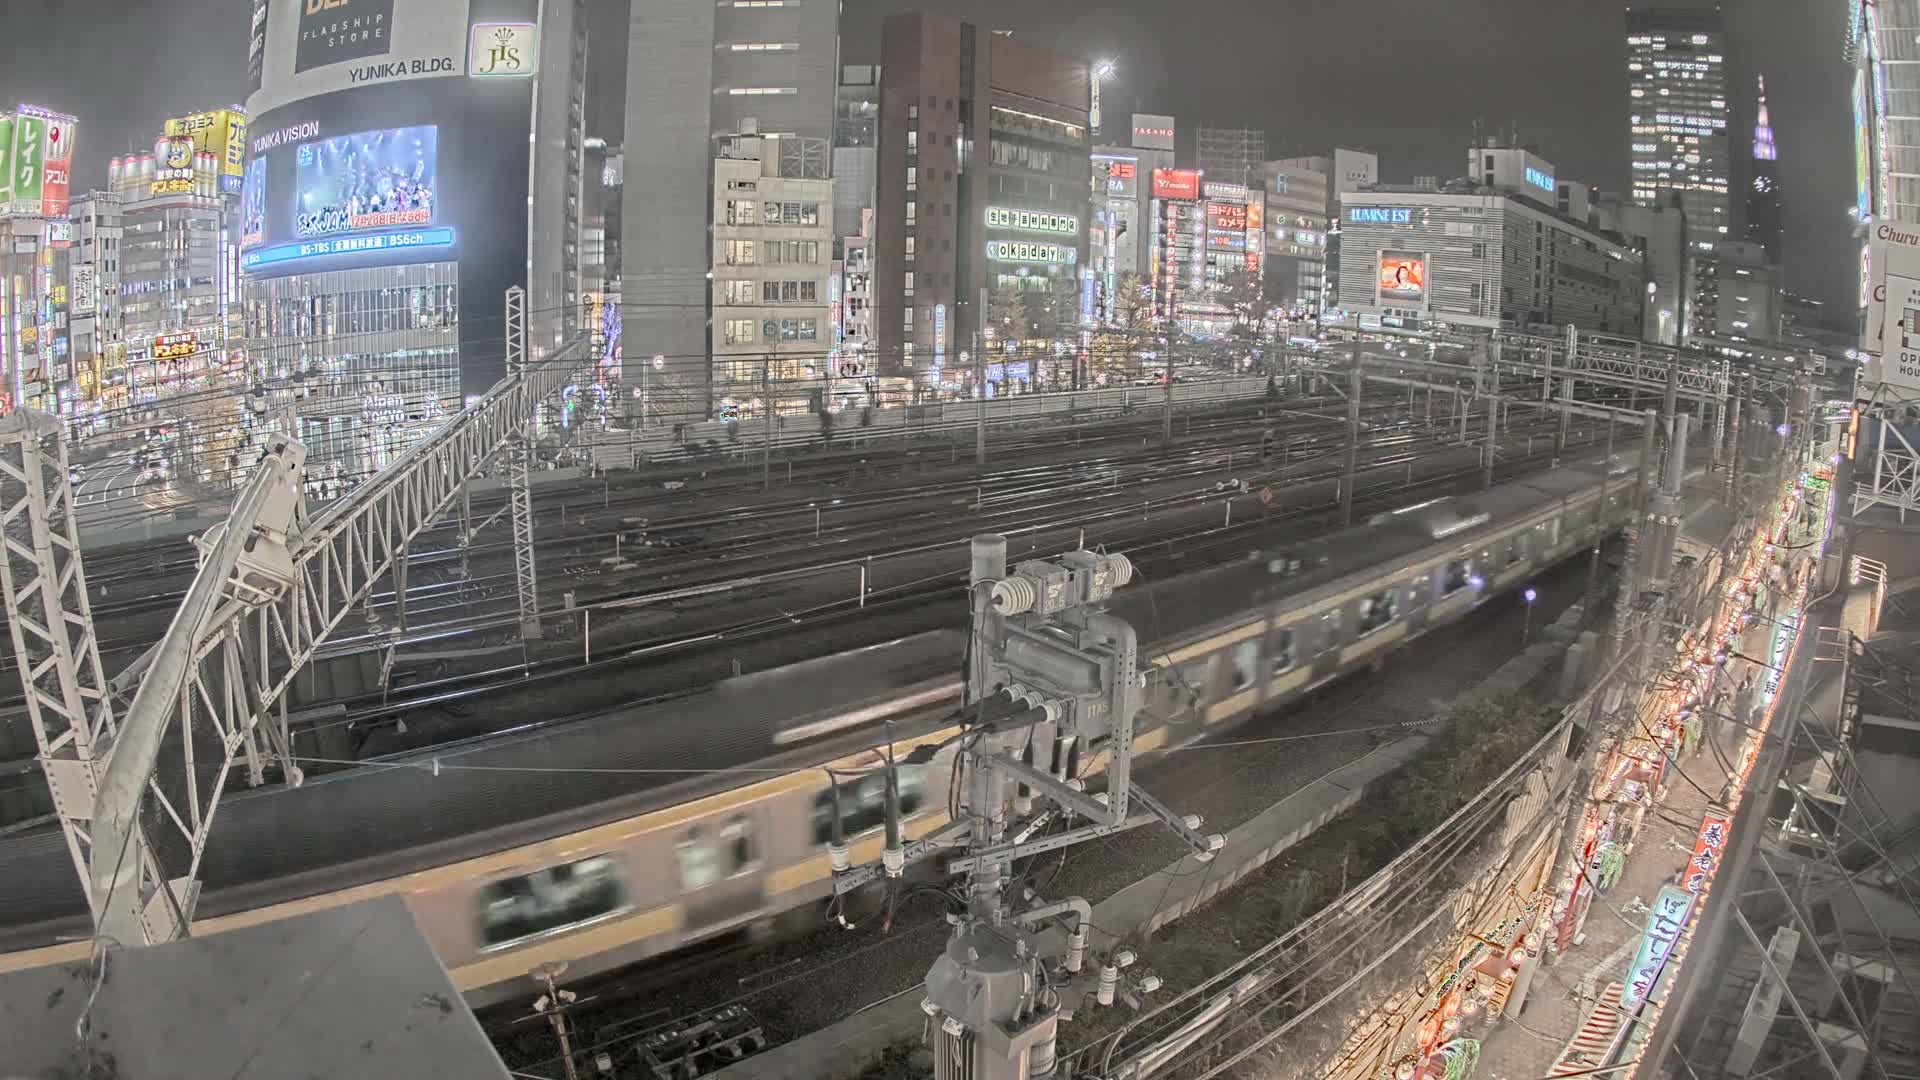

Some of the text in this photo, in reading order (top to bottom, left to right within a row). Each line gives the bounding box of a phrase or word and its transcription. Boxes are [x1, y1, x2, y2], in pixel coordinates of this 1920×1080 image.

[303, 14, 383, 40] FLAGSHIP
[329, 29, 382, 47] STORE
[350, 58, 456, 82] YUNIKA BLDG.
[254, 121, 320, 152] YUNIKA VISION
[1134, 128, 1173, 136] TAKANO
[21, 121, 37, 187] レイク
[45, 169, 68, 185] アコム
[1208, 205, 1246, 217] ヨドバシ
[1351, 208, 1411, 222] LUMINE EST
[1217, 217, 1246, 229] カメラ
[301, 241, 329, 255] BS-TBS
[390, 233, 423, 246] BS6ch
[1000, 245, 1065, 259] okadaya
